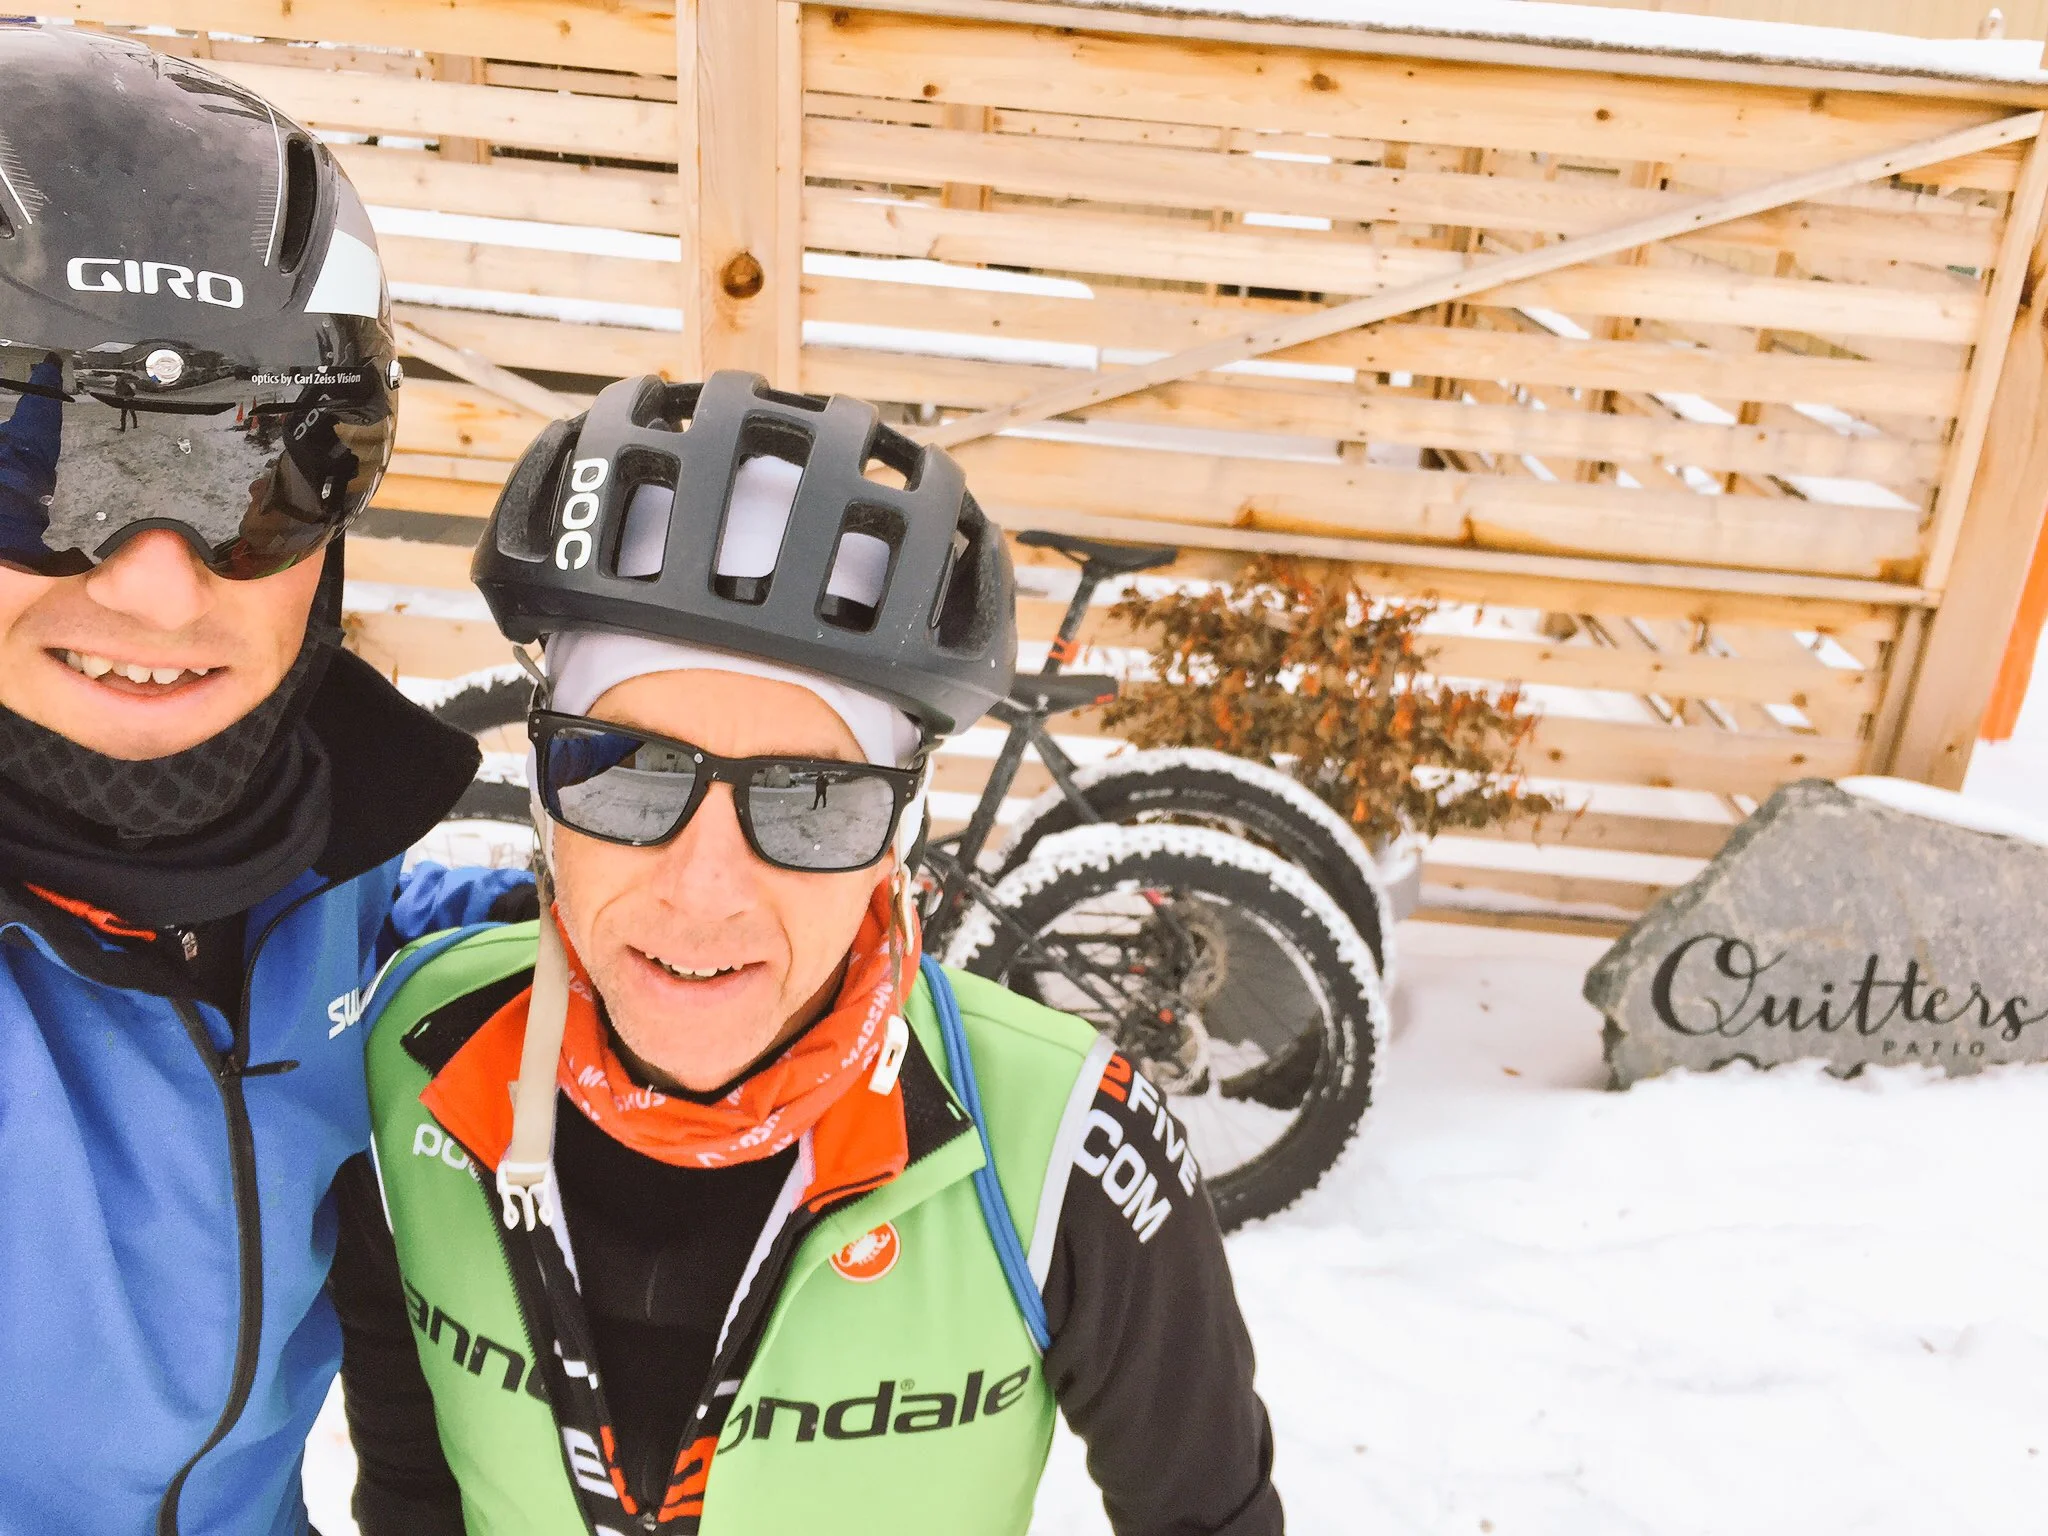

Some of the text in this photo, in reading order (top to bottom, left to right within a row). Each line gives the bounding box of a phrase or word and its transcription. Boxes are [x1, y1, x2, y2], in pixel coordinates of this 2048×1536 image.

[66, 257, 244, 309] GIRO
[251, 372, 361, 387] optics by Carl Zeiss Vision
[1651, 932, 2048, 1041] Quitters
[1881, 1039, 1986, 1058] PATIO
[1074, 1108, 1172, 1244] COM
